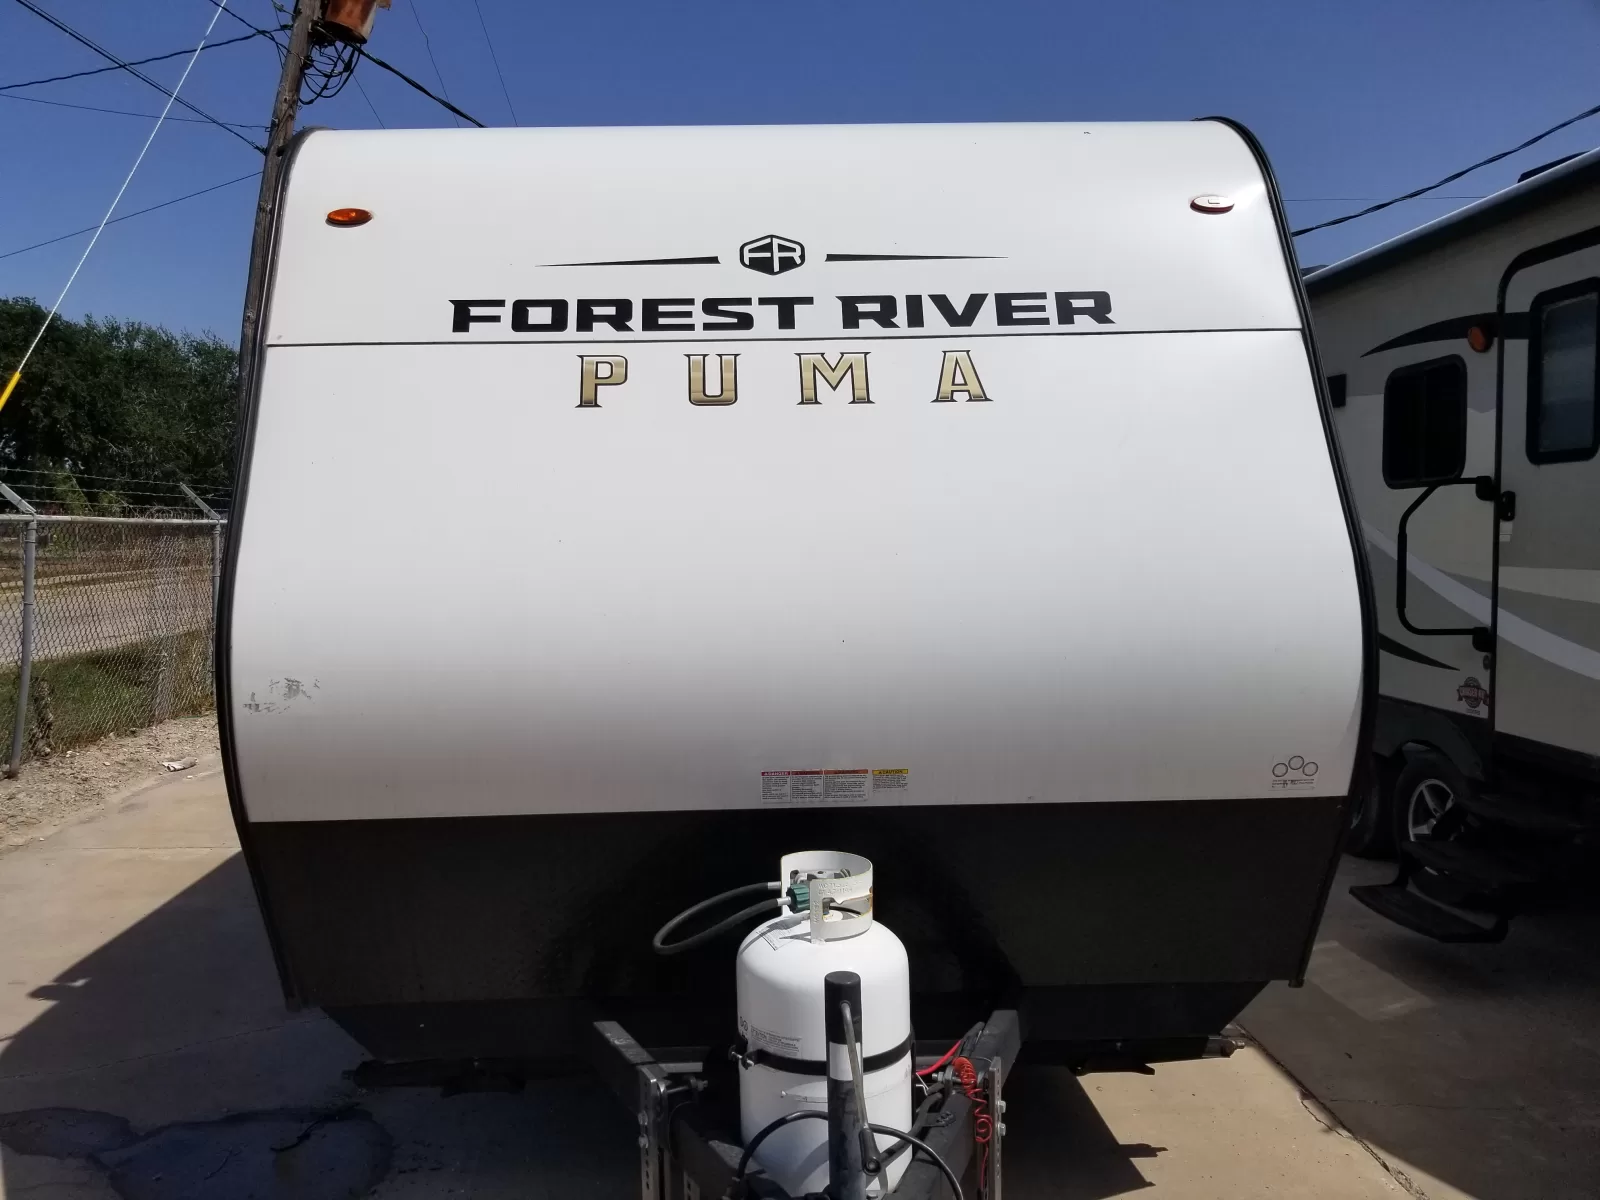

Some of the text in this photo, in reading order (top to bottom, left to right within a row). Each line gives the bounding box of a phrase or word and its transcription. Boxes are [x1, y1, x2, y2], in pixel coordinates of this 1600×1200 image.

[448, 290, 1117, 333] FOREST RIVER
[574, 349, 994, 409] PUMA
